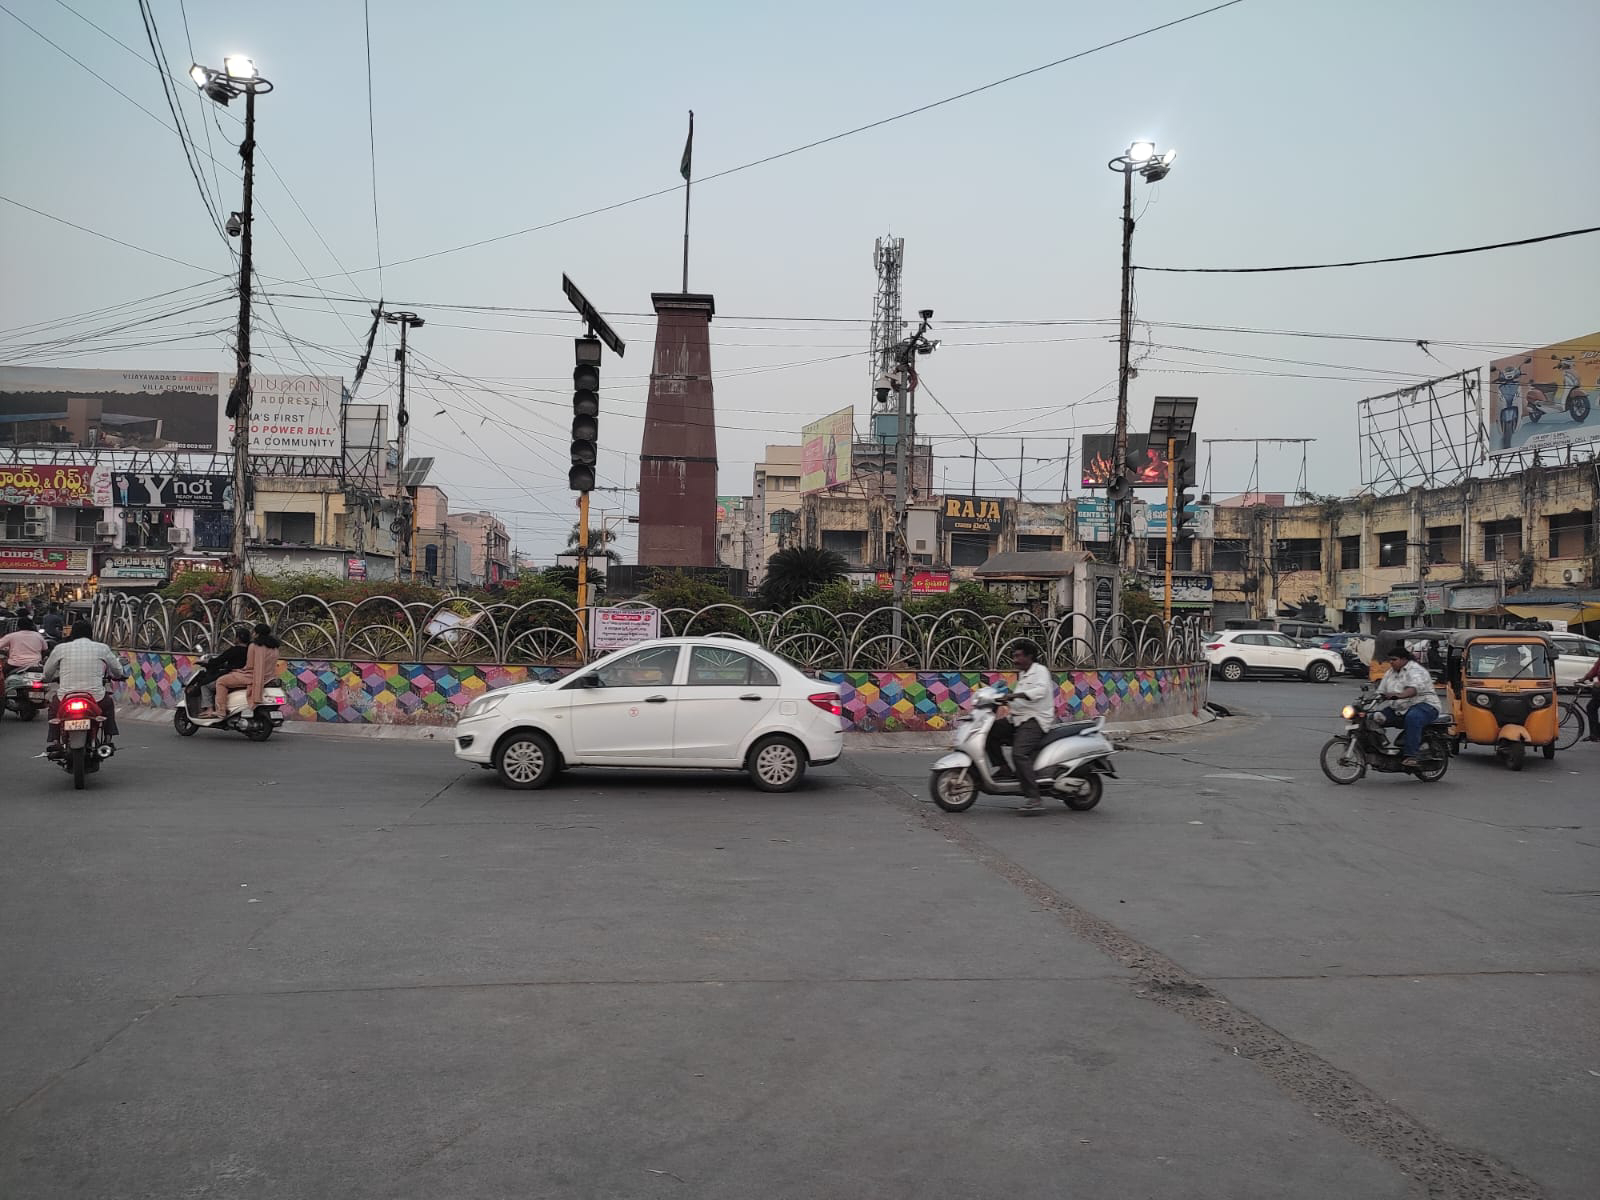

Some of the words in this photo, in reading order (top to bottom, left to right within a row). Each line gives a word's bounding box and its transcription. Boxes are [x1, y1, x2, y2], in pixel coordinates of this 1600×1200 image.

[261, 396, 319, 405] ADDRESS
[274, 414, 305, 422] FIRST
[228, 424, 259, 433] ZO
[262, 426, 304, 434] POWER
[264, 437, 335, 447] COMMUNITY
[44, 478, 51, 488] &
[135, 474, 173, 507] Y
[946, 499, 1001, 519] RAJA
